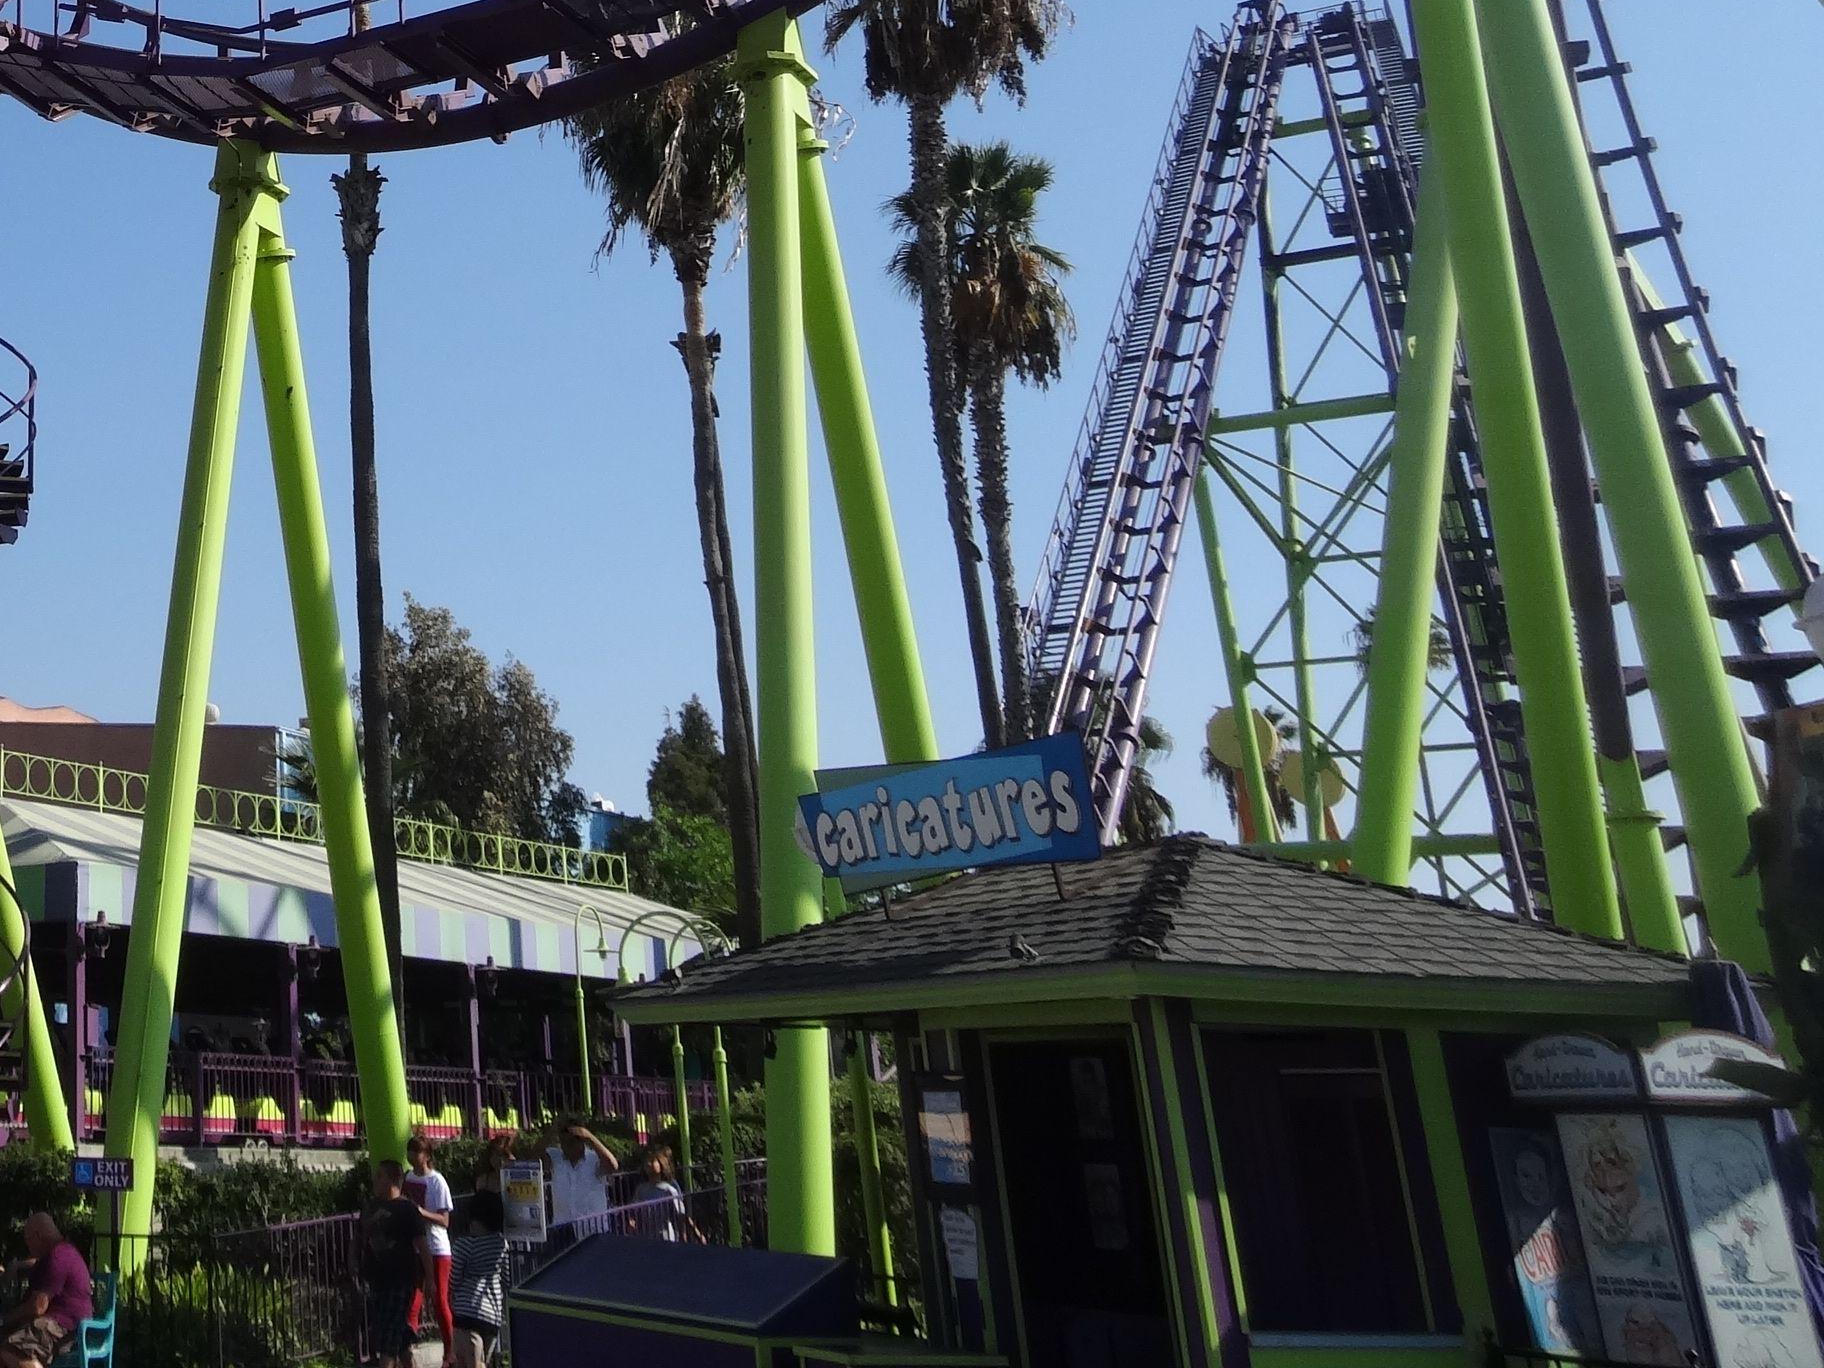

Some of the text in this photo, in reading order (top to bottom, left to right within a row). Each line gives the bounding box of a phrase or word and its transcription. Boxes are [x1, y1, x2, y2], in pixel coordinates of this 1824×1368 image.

[816, 770, 1080, 867] caricatures
[97, 1161, 127, 1173] EXIT
[95, 1175, 129, 1188] ONLY
